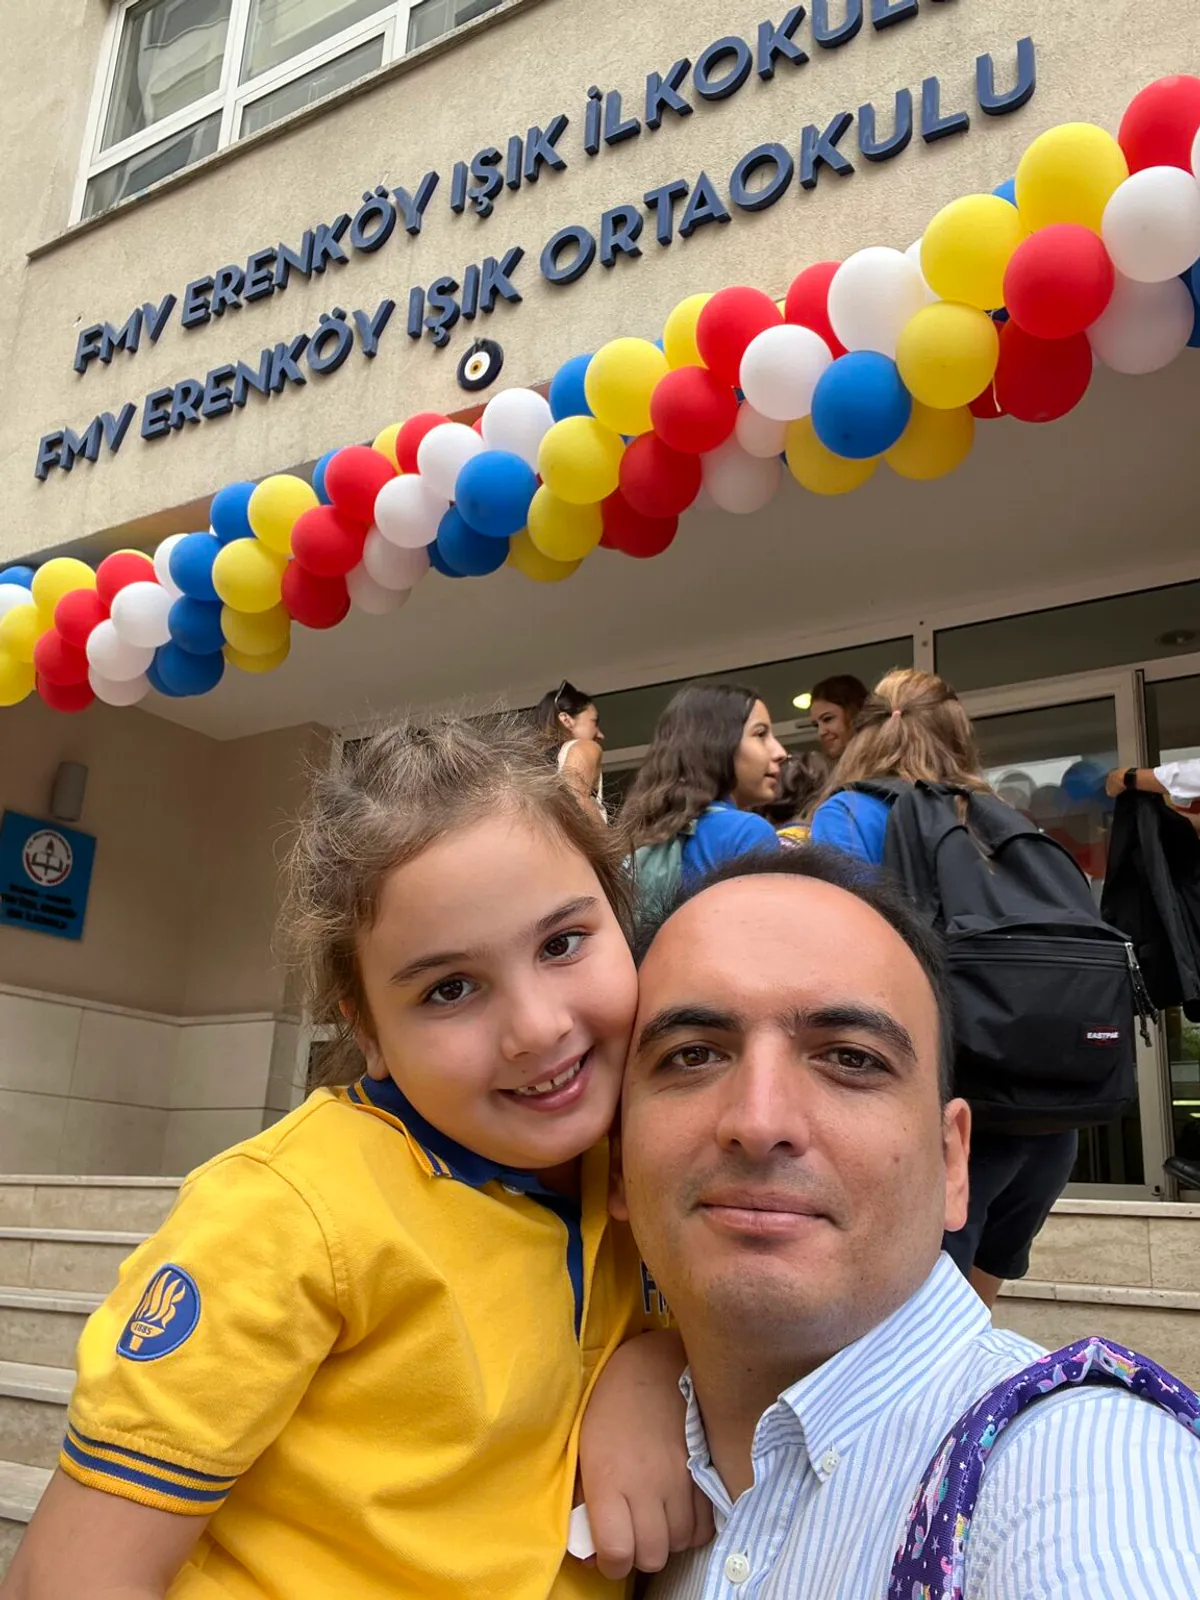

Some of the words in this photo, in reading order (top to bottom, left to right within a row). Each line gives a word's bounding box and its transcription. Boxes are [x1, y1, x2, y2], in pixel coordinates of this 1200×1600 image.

[36, 403, 137, 481] FMV
[141, 299, 396, 441] ERENKÖY
[407, 247, 525, 349] IŞIK
[540, 37, 1035, 287] ORTAOKULU
[75, 294, 177, 374] FMV
[181, 171, 439, 330] ERENKÖY
[450, 114, 569, 219] IŞIK
[584, 0, 953, 158] İLKOKUL
[134, 1323, 153, 1336] 1885
